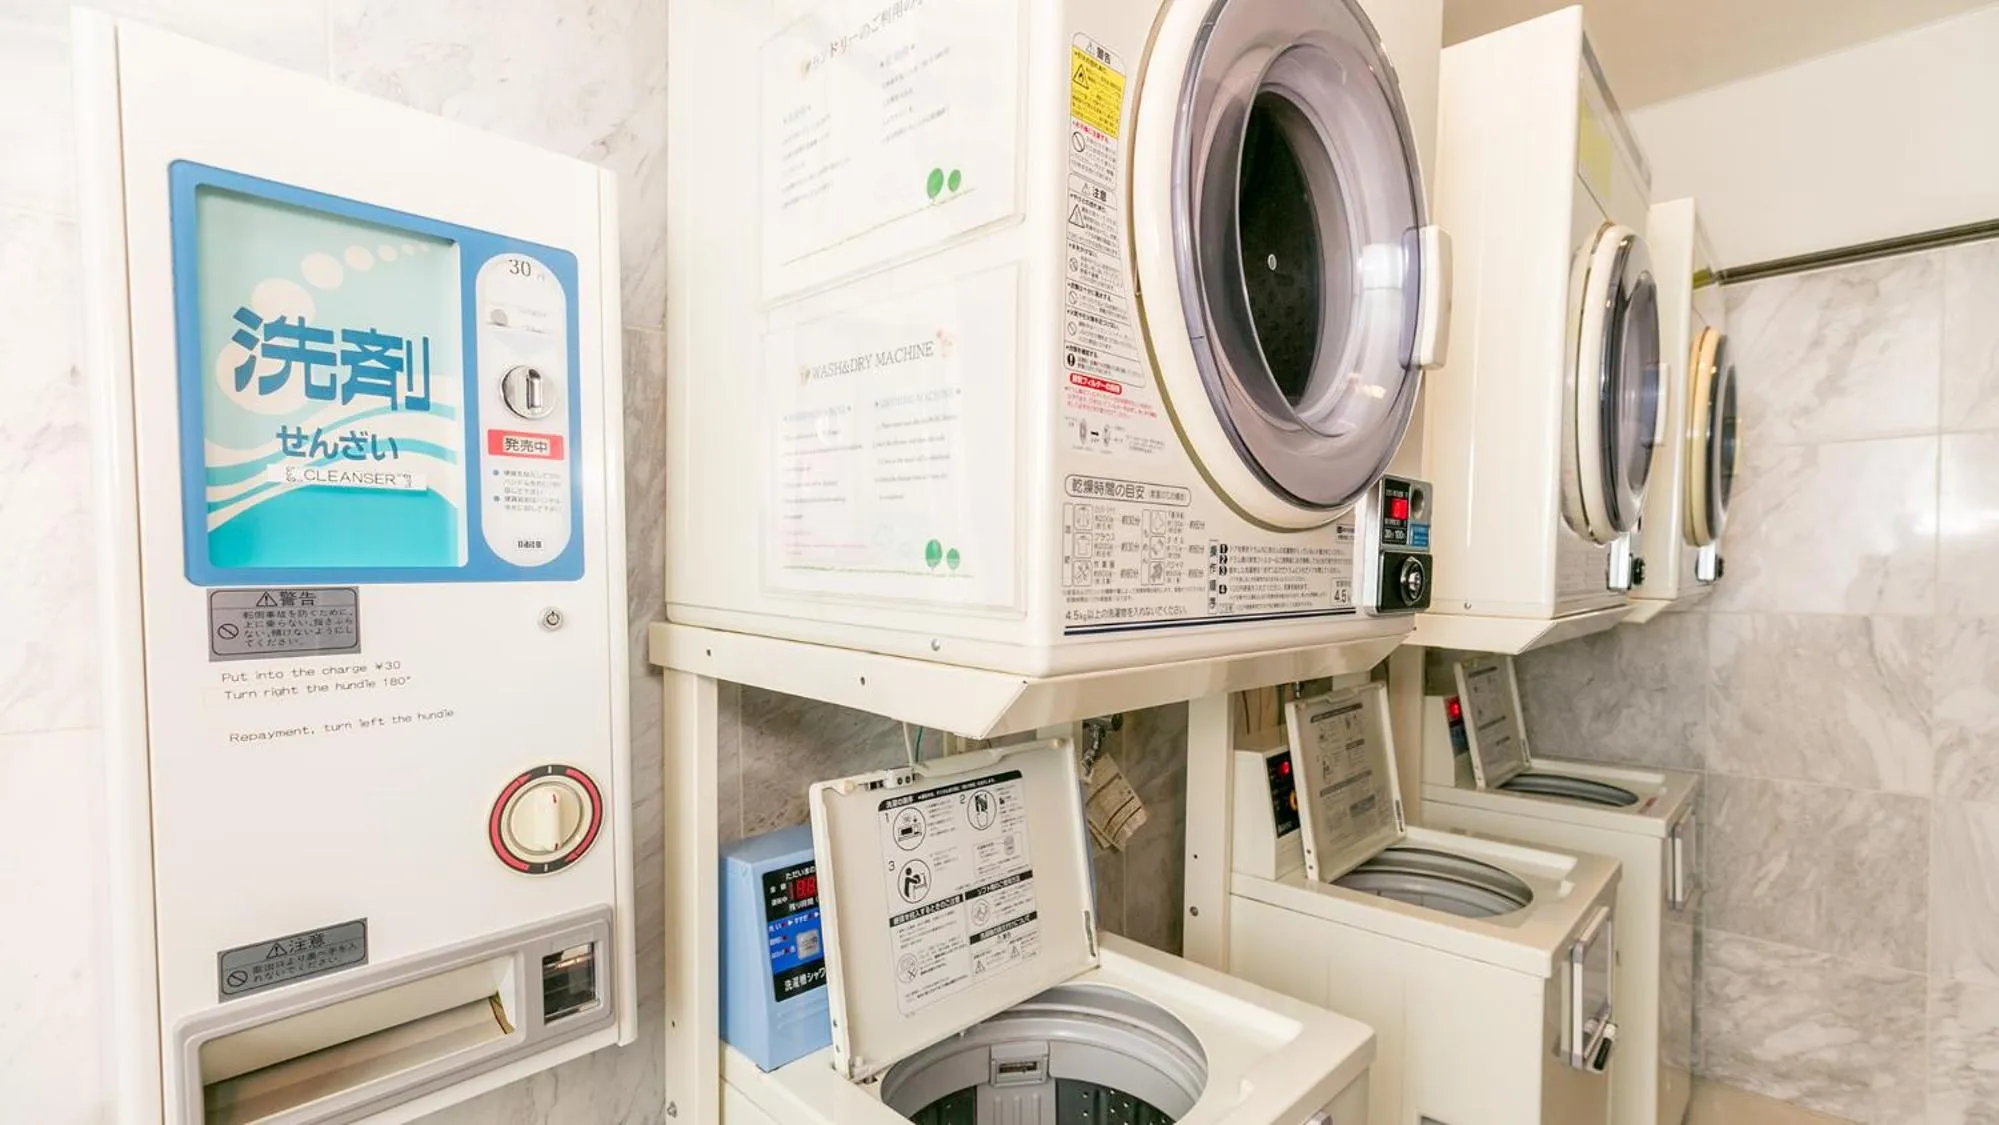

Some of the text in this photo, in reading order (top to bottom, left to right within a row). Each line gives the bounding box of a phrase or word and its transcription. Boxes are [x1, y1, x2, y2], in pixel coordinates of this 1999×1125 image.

[232, 306, 431, 412] 洗剤
[812, 340, 935, 380] WASH&DRY MACHINE
[276, 425, 399, 461] せんざい
[504, 437, 548, 453] 発売中
[304, 468, 396, 486] CLEANSER
[279, 591, 317, 606] 警告
[222, 660, 401, 683] Put into the charge ¥30
[224, 688, 258, 701] Turn
[263, 685, 298, 699] right
[306, 682, 329, 694] the
[229, 724, 316, 743] Repayment,
[324, 721, 353, 733] turn
[359, 715, 386, 729] left
[391, 713, 413, 724] the
[959, 794, 967, 805] 2
[888, 860, 896, 872] 3
[288, 933, 326, 954] 注意
